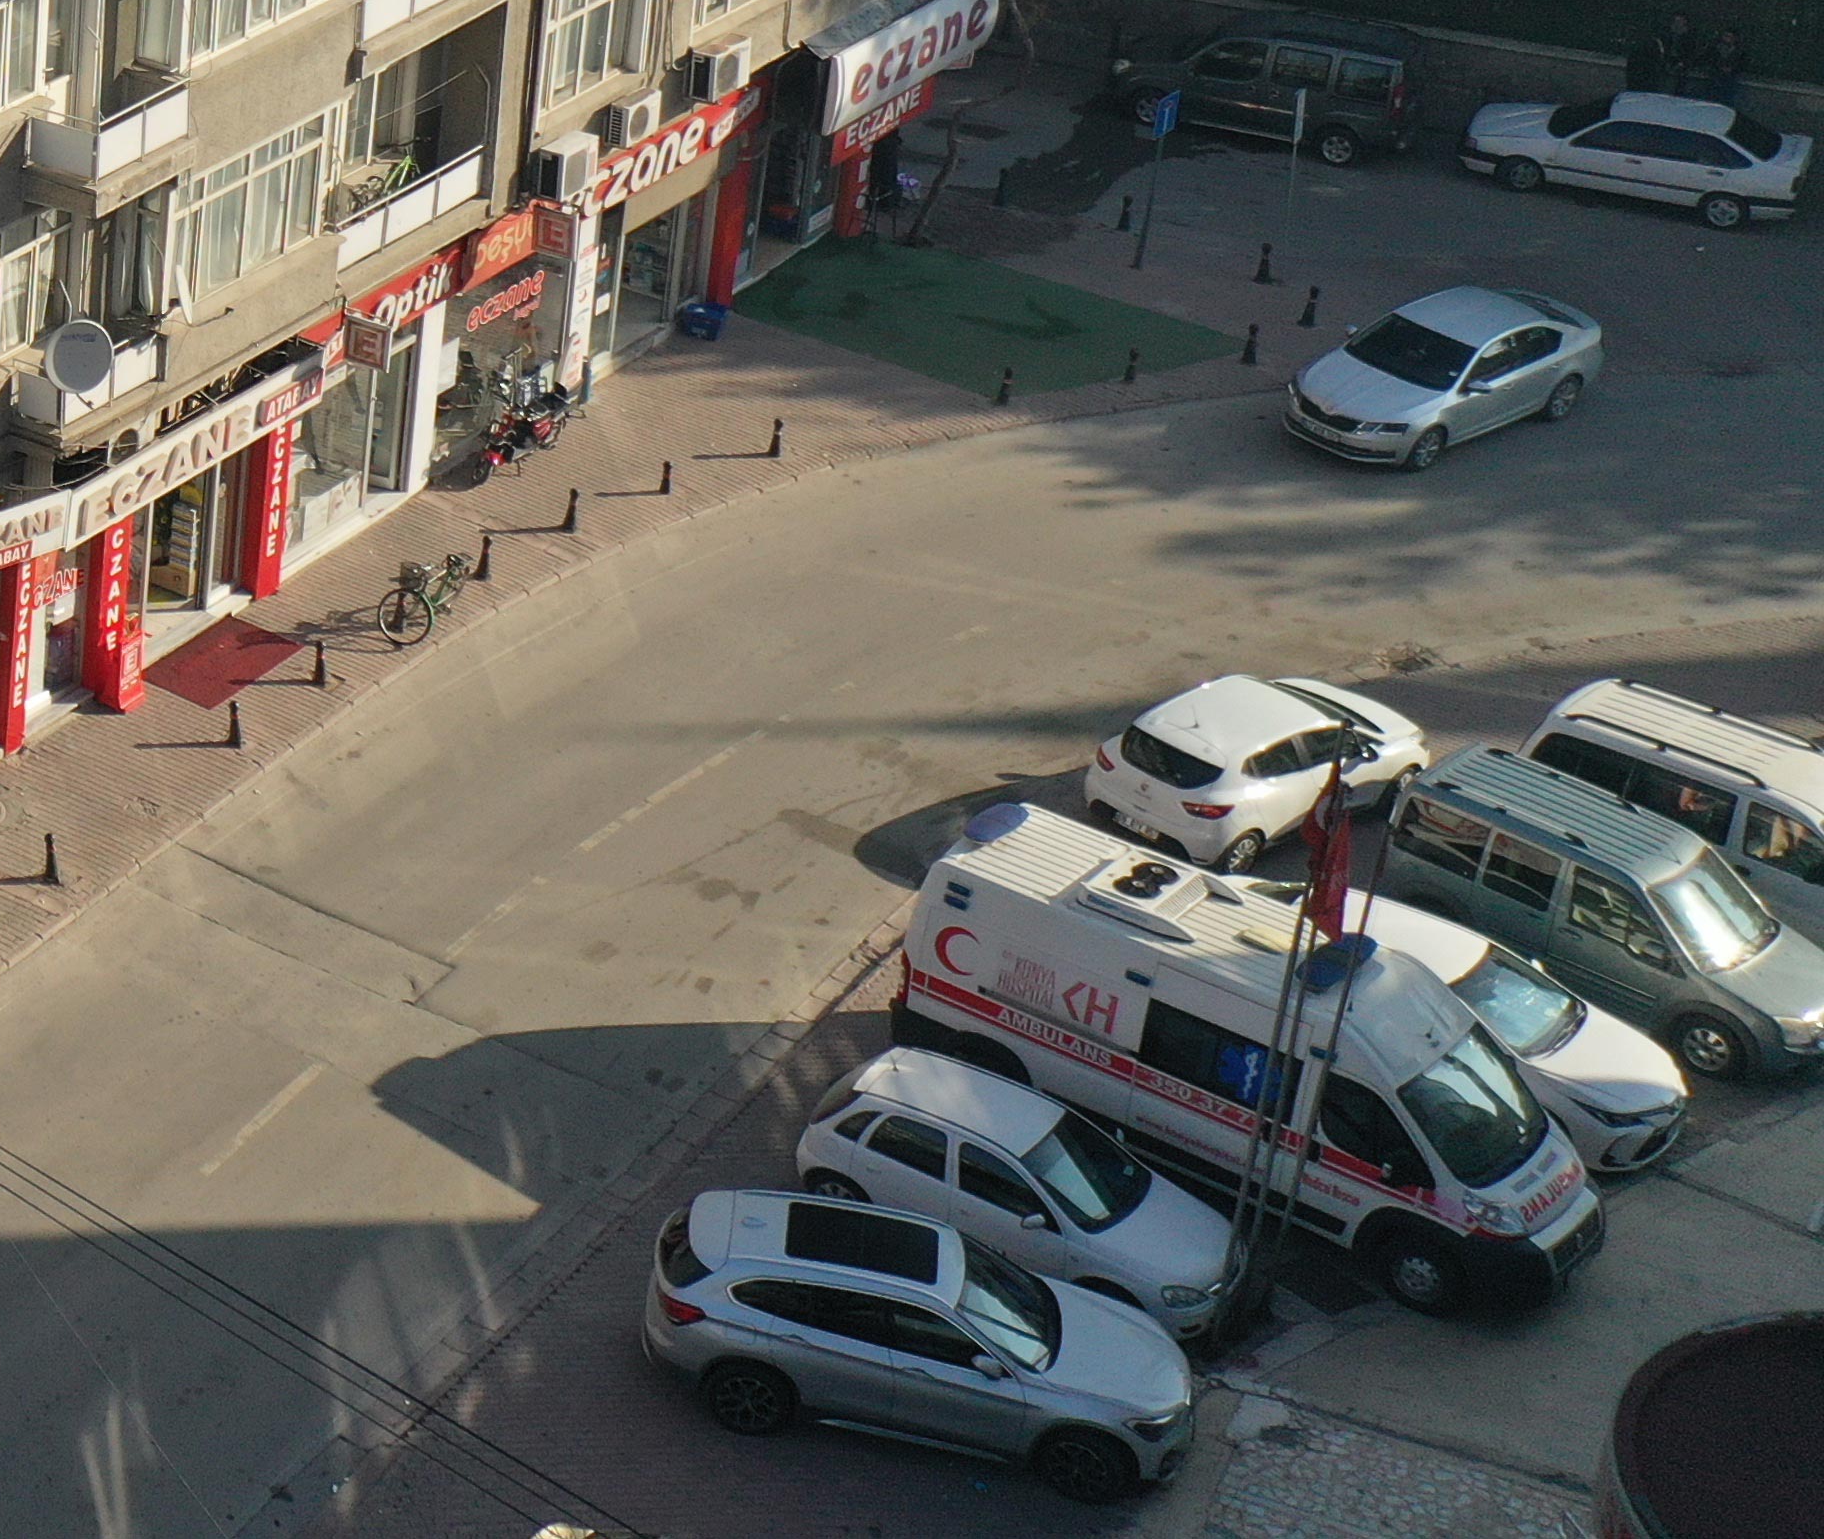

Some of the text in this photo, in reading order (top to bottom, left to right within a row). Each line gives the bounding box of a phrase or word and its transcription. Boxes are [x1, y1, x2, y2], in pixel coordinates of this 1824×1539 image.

[844, 83, 922, 149] ECZANE
[466, 269, 545, 333] eczane
[266, 370, 321, 423] ATABAY
[81, 405, 253, 538] ECZANE
[106, 527, 125, 652] CZANE
[12, 561, 32, 709] ECZANE
[998, 1008, 1112, 1068] AMBULANS
